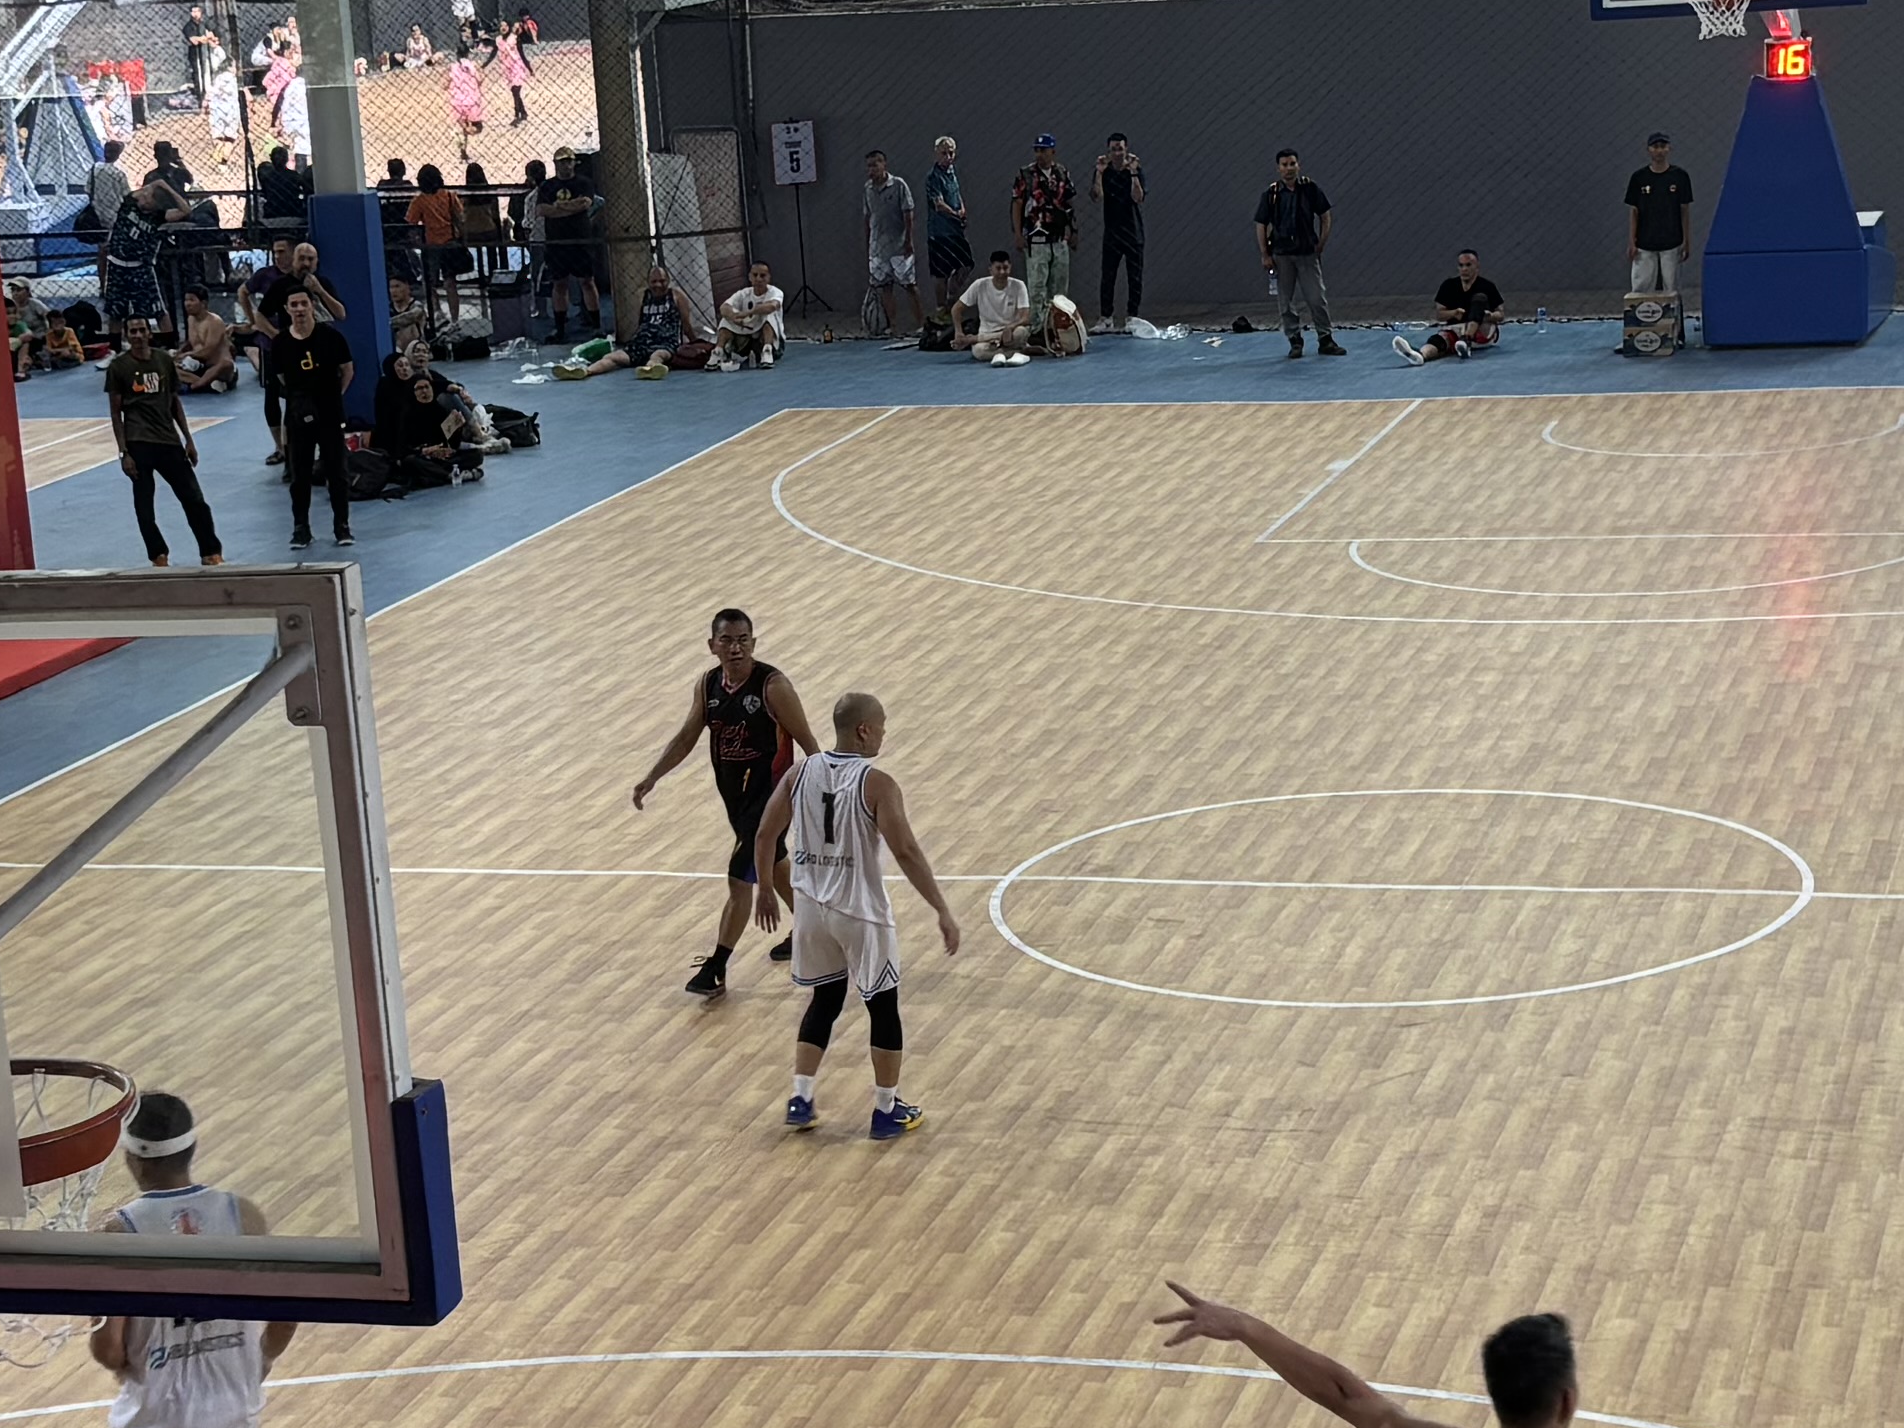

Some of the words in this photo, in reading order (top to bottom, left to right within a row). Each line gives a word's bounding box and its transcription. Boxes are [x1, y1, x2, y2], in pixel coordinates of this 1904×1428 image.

[1777, 44, 1805, 75] 16
[788, 150, 801, 174] 5
[821, 791, 836, 845] 1
